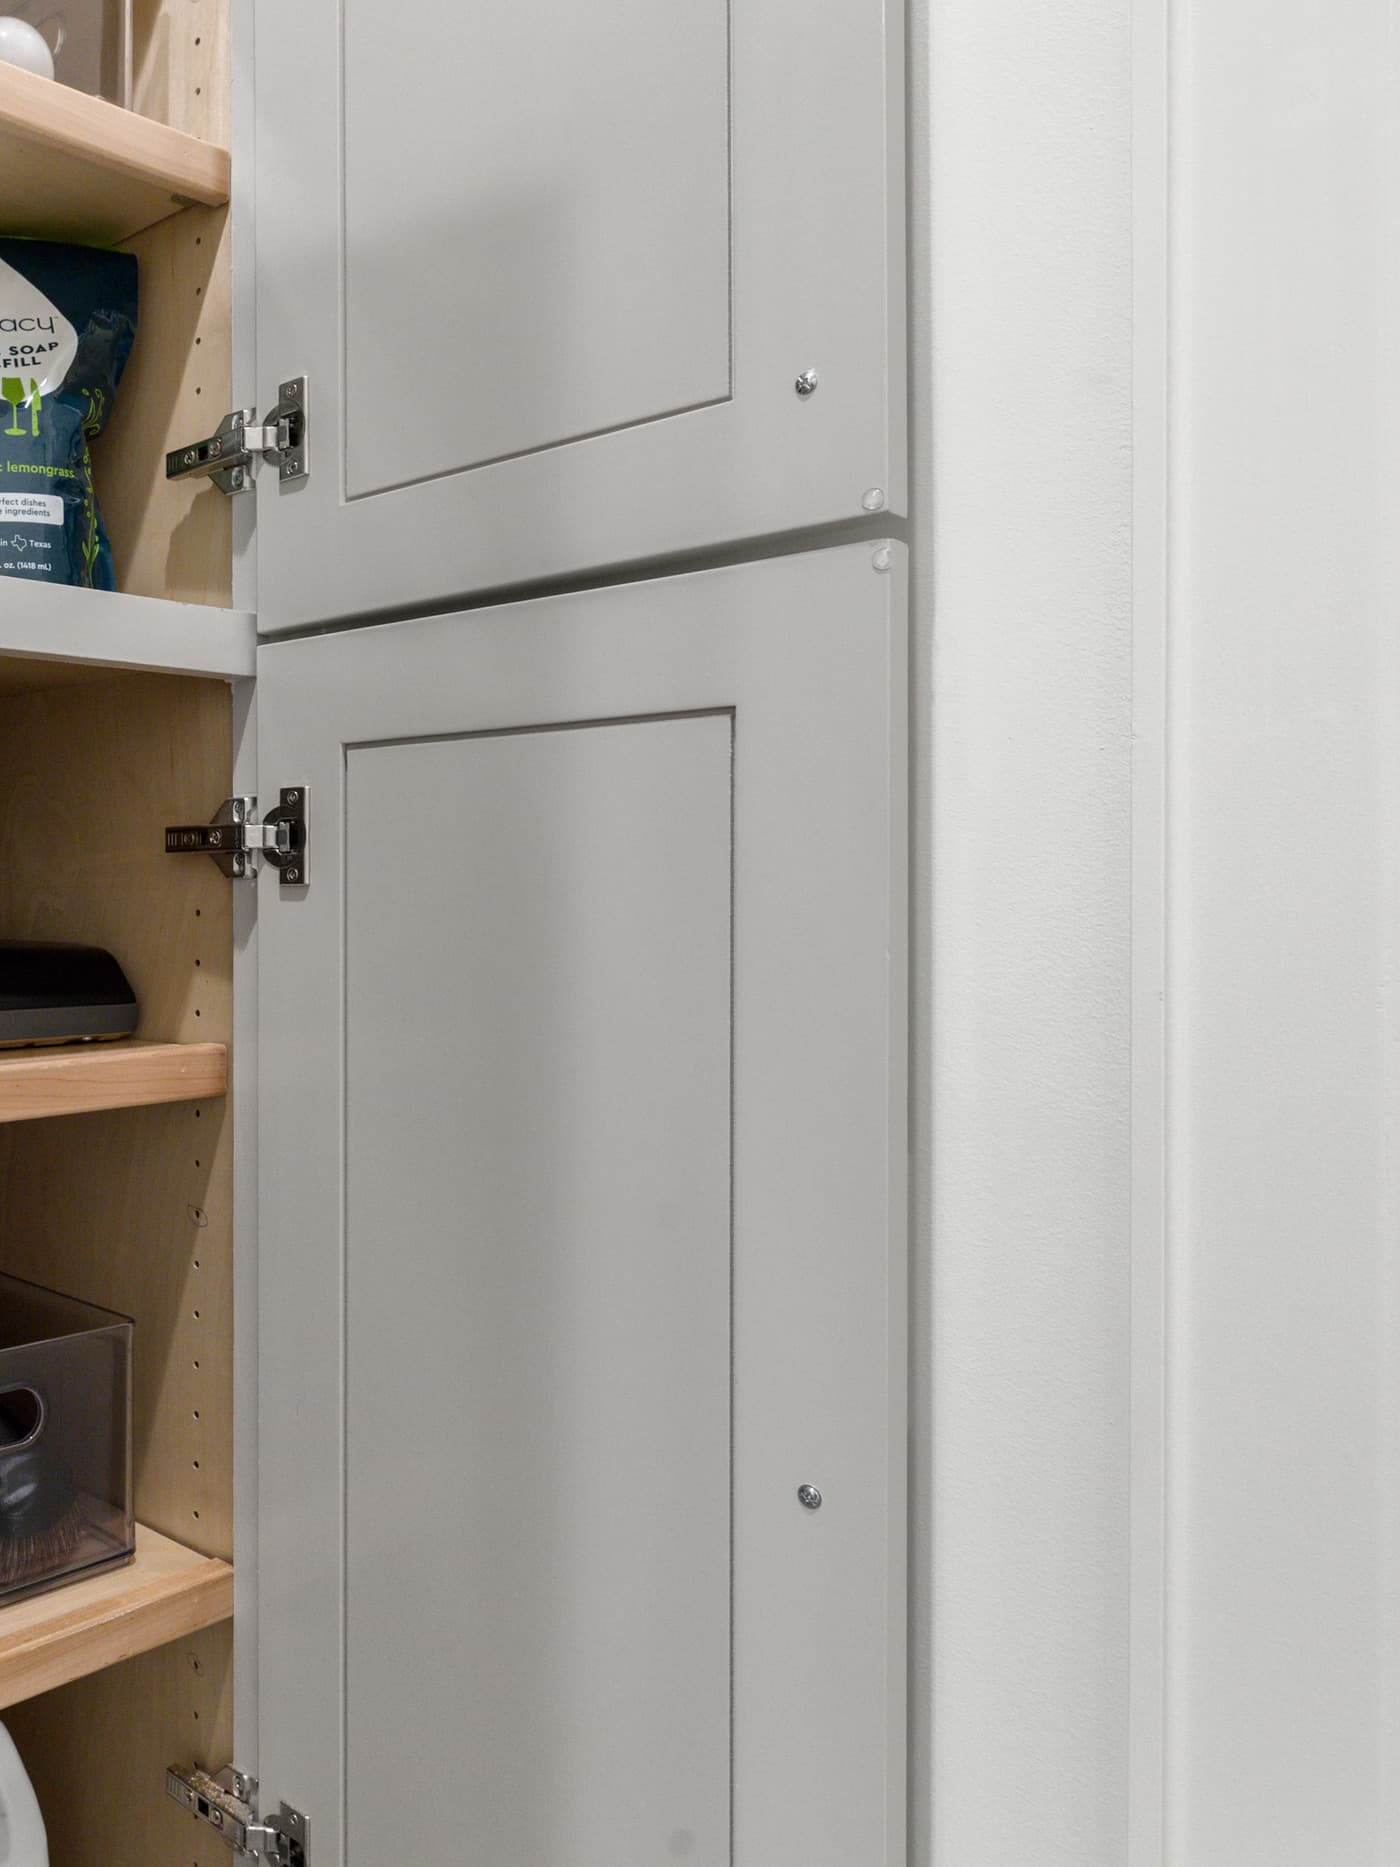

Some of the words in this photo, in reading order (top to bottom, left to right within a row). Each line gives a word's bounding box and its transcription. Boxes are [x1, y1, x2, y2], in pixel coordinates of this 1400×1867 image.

[8, 341, 59, 356] SOAP
[7, 460, 75, 478] lemongrass
[21, 497, 47, 507] dishes
[4, 507, 50, 517] ingredients
[29, 540, 52, 549] Texas
[16, 562, 36, 570] (1418
